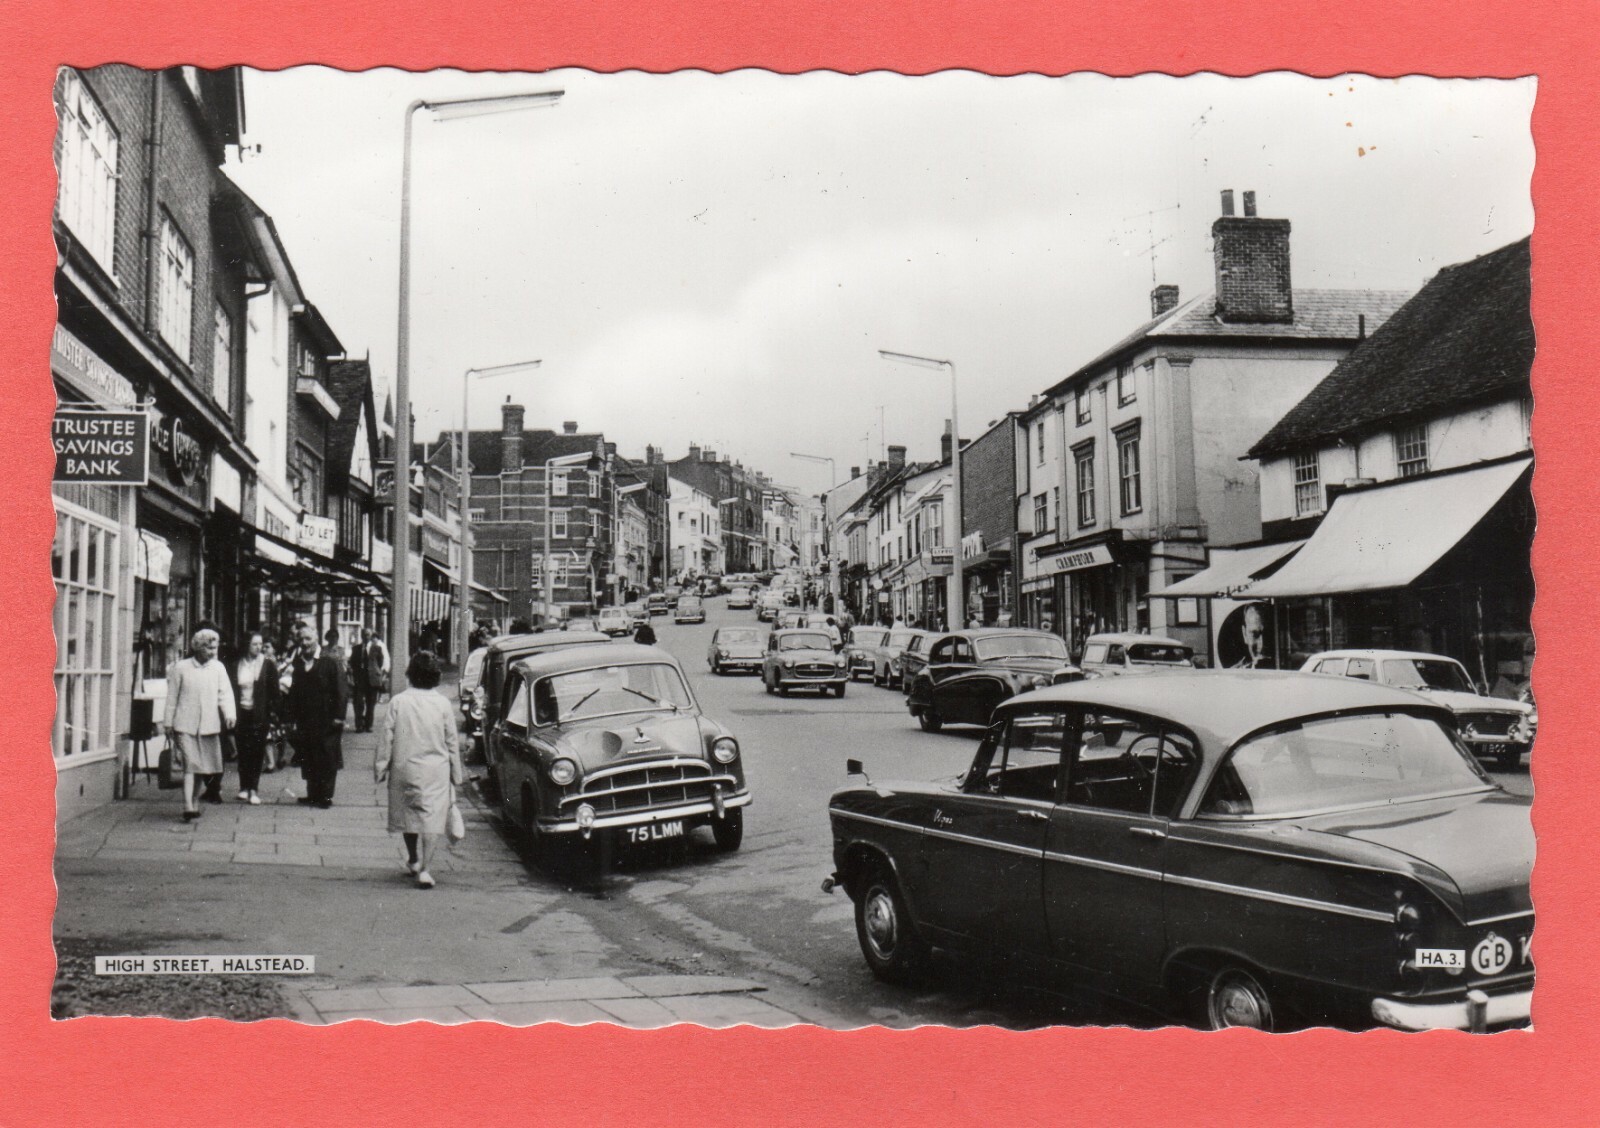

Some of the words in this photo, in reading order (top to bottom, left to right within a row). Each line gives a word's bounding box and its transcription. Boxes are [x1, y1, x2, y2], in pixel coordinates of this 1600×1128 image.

[53, 418, 135, 436] TRUSTEE
[55, 438, 134, 456] SAVINGS
[66, 459, 122, 476] BANK
[304, 525, 315, 537] TO
[319, 528, 334, 539] LET
[627, 826, 649, 842] 75
[651, 821, 683, 839] LMM
[1478, 943, 1506, 970] GB
